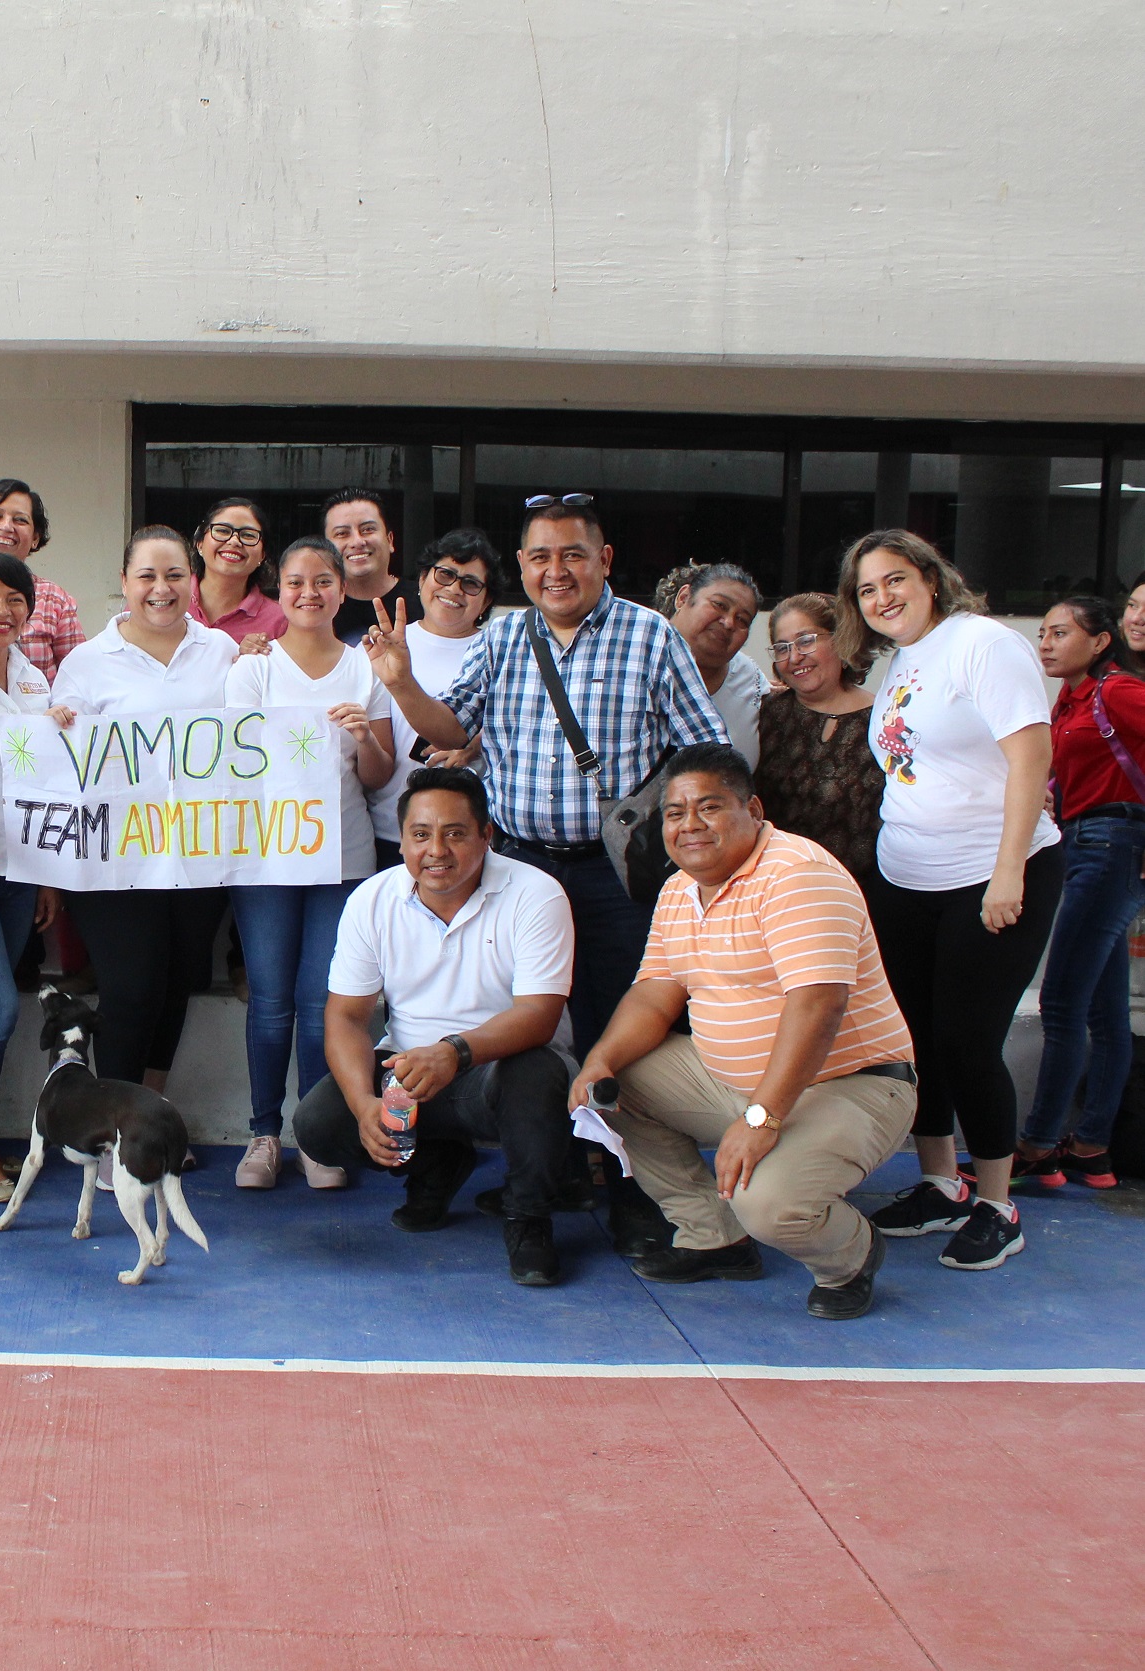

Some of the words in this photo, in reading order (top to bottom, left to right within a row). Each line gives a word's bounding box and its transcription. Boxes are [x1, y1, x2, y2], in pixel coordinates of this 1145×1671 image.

[58, 712, 269, 793] VAMOS
[15, 799, 110, 862] TEAM
[119, 799, 324, 858] ADMITIVOS
